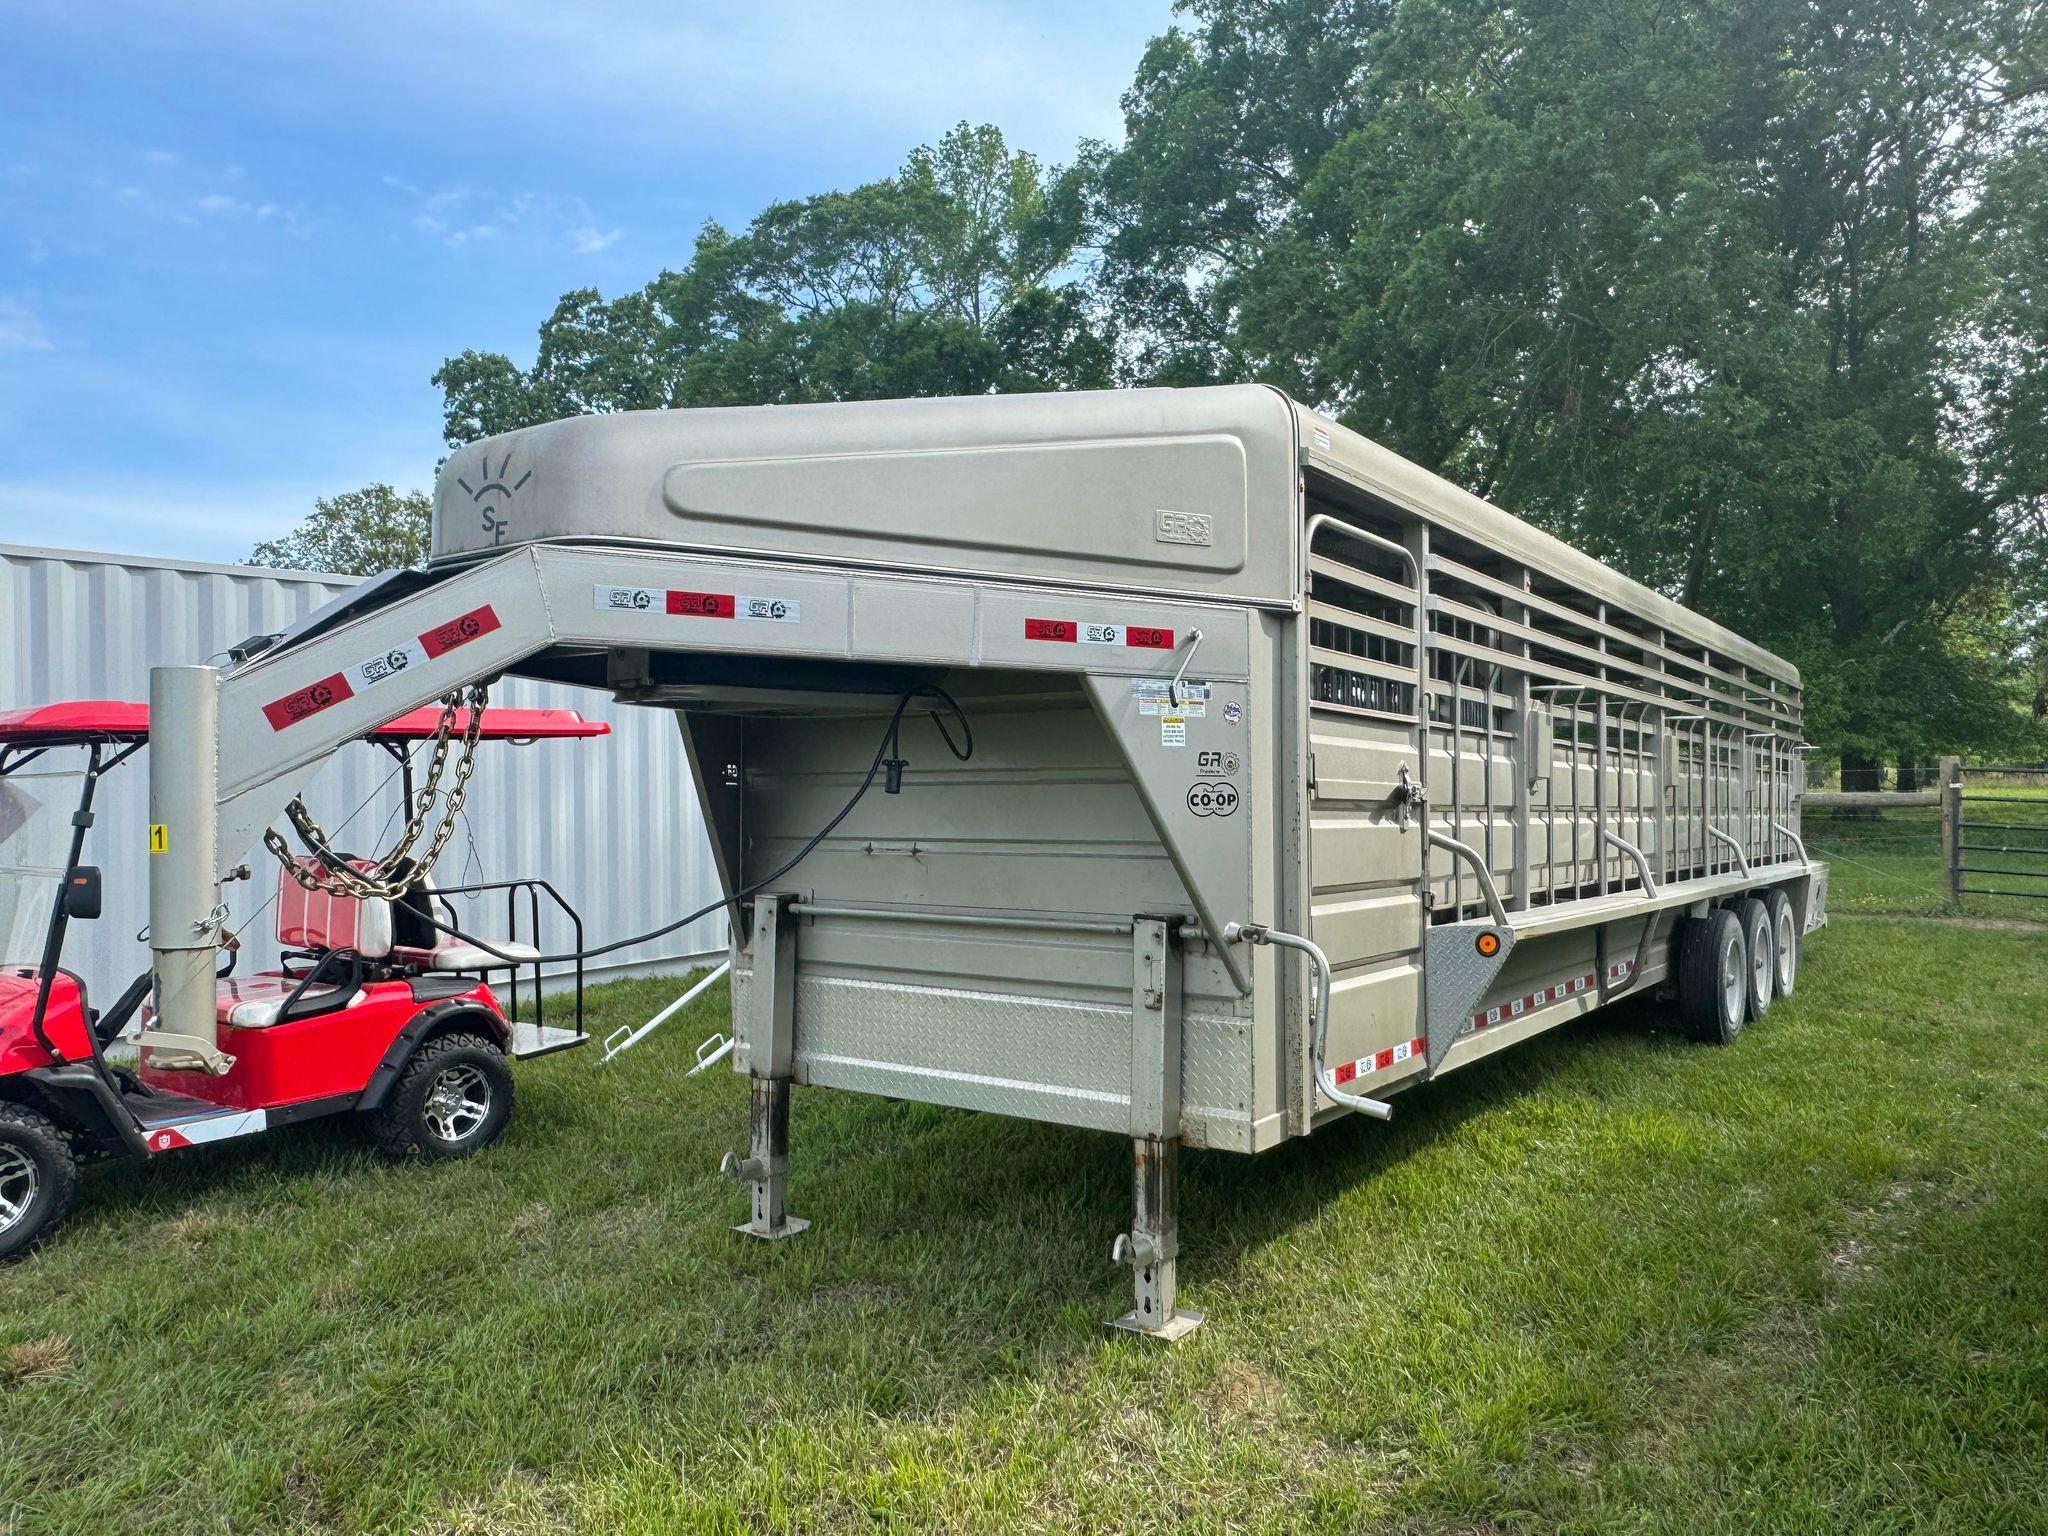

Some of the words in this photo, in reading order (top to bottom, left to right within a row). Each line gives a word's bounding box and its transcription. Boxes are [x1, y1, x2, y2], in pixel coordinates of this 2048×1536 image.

[361, 657, 387, 678] GR
[1198, 752, 1221, 767] GR
[1190, 794, 1237, 807] CO-OP
